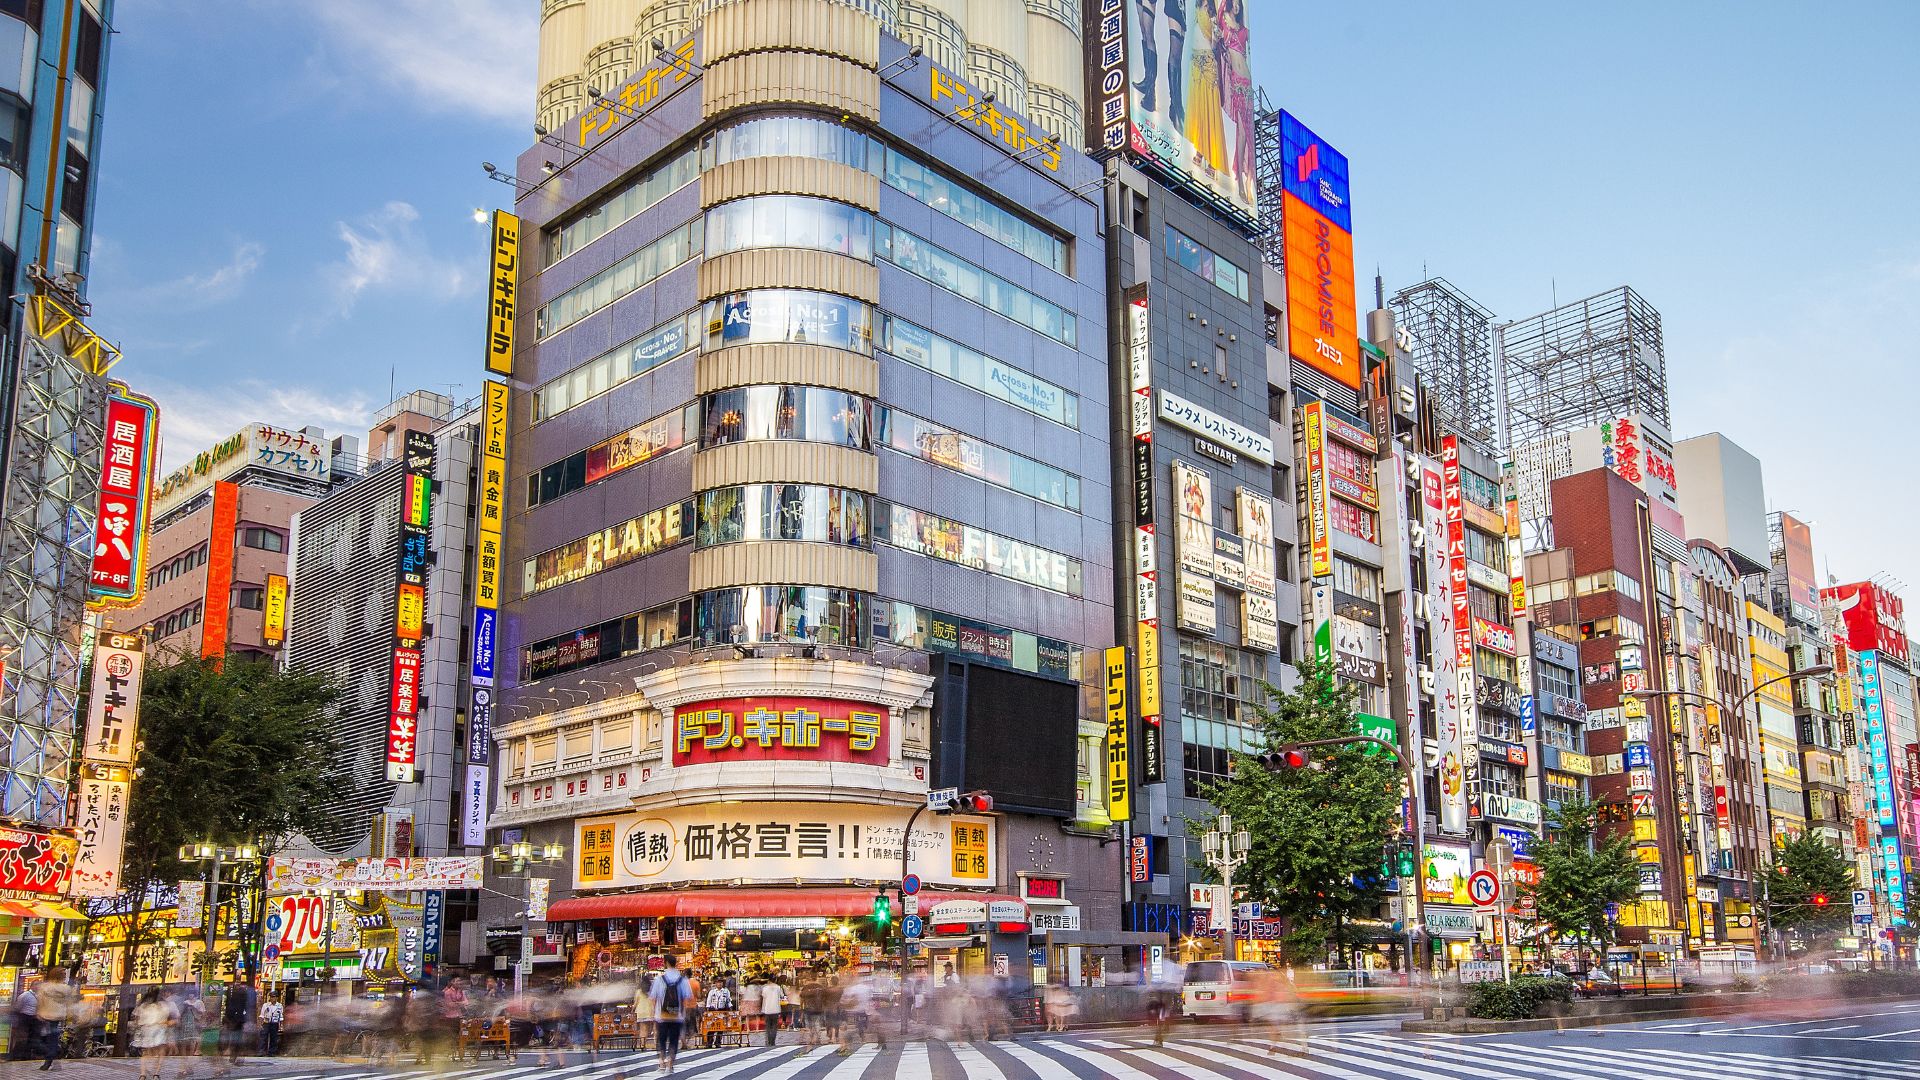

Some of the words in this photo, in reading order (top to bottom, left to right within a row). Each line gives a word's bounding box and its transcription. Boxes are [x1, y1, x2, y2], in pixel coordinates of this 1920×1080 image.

[1315, 219, 1335, 338] PROMISE
[1314, 336, 1343, 366] プロミス
[488, 387, 506, 455] ブランド品
[1376, 404, 1387, 449] 水上ビル
[106, 420, 138, 490] 居酒屋
[194, 450, 210, 477] Big
[211, 432, 242, 465] Lemon
[257, 445, 330, 476] カプセル
[1200, 440, 1238, 464] SQUARE
[484, 469, 501, 521] 貴金属
[1138, 445, 1148, 516] ザ・ロックアップ
[1443, 446, 1459, 520] カラオケ
[94, 502, 131, 561] つぼ八
[404, 524, 415, 532] New
[405, 537, 415, 548] de
[586, 502, 682, 568] FLARE
[403, 550, 414, 573] Elle
[413, 535, 426, 565] Castle
[939, 549, 984, 570] STUDIO
[963, 524, 1067, 586] FLARE
[480, 539, 497, 601] 高額買取
[535, 575, 565, 592] PHOTO
[566, 561, 603, 581] STUDIO
[1246, 575, 1275, 592] Carnival
[1450, 540, 1467, 611] パセラ
[111, 635, 136, 650] 6F
[402, 638, 416, 648] 6F
[579, 637, 599, 649] 時計
[932, 620, 957, 641] 販売
[961, 631, 985, 643] ブランド
[989, 636, 1010, 650] 時計
[1434, 518, 1456, 743] カラオケパセラ
[109, 656, 120, 674] 元祖
[559, 644, 577, 657] ブランド
[119, 657, 130, 675] 東京
[1144, 631, 1153, 704] アラビアンロック
[397, 668, 414, 714] 居楽屋
[1460, 671, 1472, 727] パーティー
[1521, 697, 1533, 729] 747
[1147, 730, 1156, 775] ミステリアス
[95, 767, 121, 781] 5F
[472, 780, 481, 826] 写真スタジオ
[470, 829, 480, 839] 5F
[583, 828, 612, 848] 情熱
[627, 830, 669, 863] 情熱
[684, 821, 861, 861] 価格宣言!!
[954, 826, 985, 847] 情熱
[583, 854, 611, 877] 価格
[954, 853, 985, 874] 価格
[1133, 849, 1147, 882] ダイコク
[15, 889, 34, 900] YAKI
[1854, 892, 1865, 905] P
[280, 896, 324, 952] 270
[356, 914, 384, 928] カラオケ
[424, 892, 441, 951] カラオケ
[906, 920, 915, 934] P
[1034, 915, 1078, 929] 価格宣言!!
[359, 946, 387, 970] 747
[405, 926, 418, 975] カラオケ
[424, 952, 437, 962] B1
[1153, 948, 1160, 961] P
